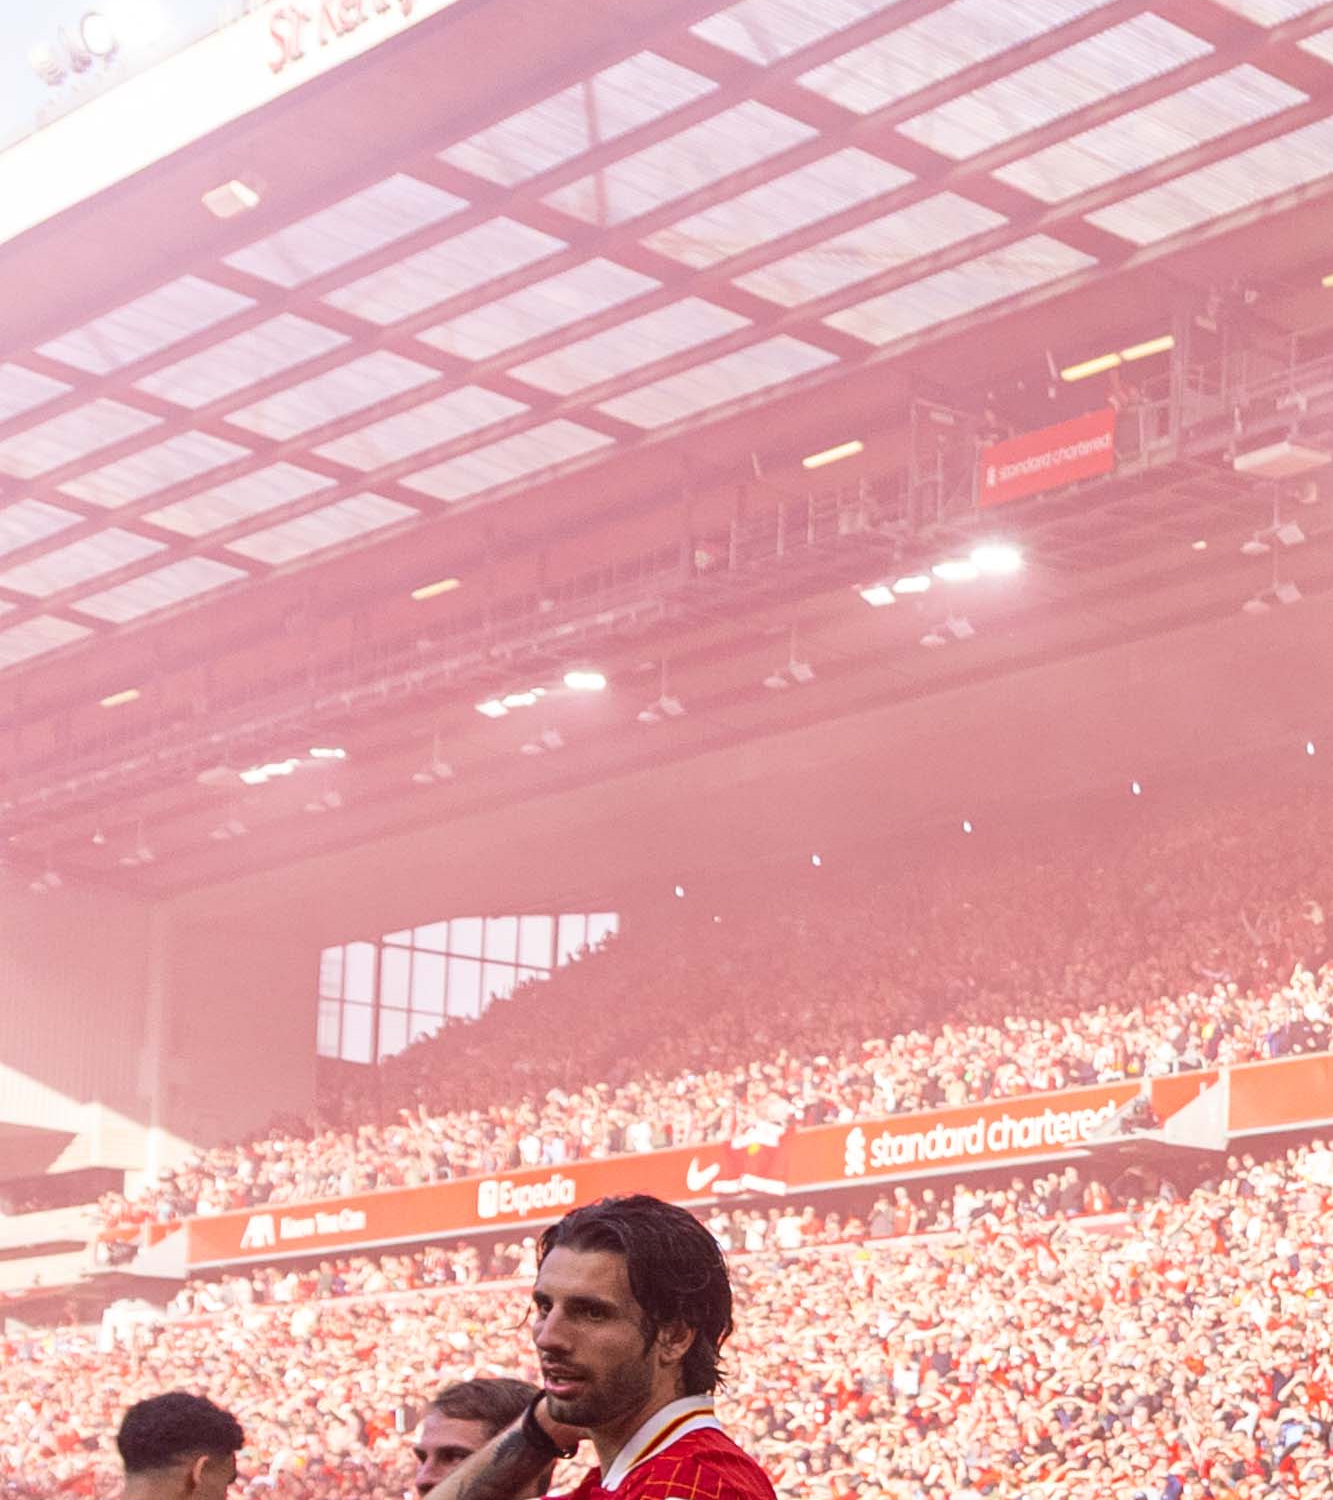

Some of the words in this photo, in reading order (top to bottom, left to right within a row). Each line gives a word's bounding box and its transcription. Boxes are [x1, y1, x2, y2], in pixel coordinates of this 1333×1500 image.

[869, 1117, 985, 1168] standard
[987, 1101, 1116, 1156] chartered
[500, 1174, 576, 1216] Expedia
